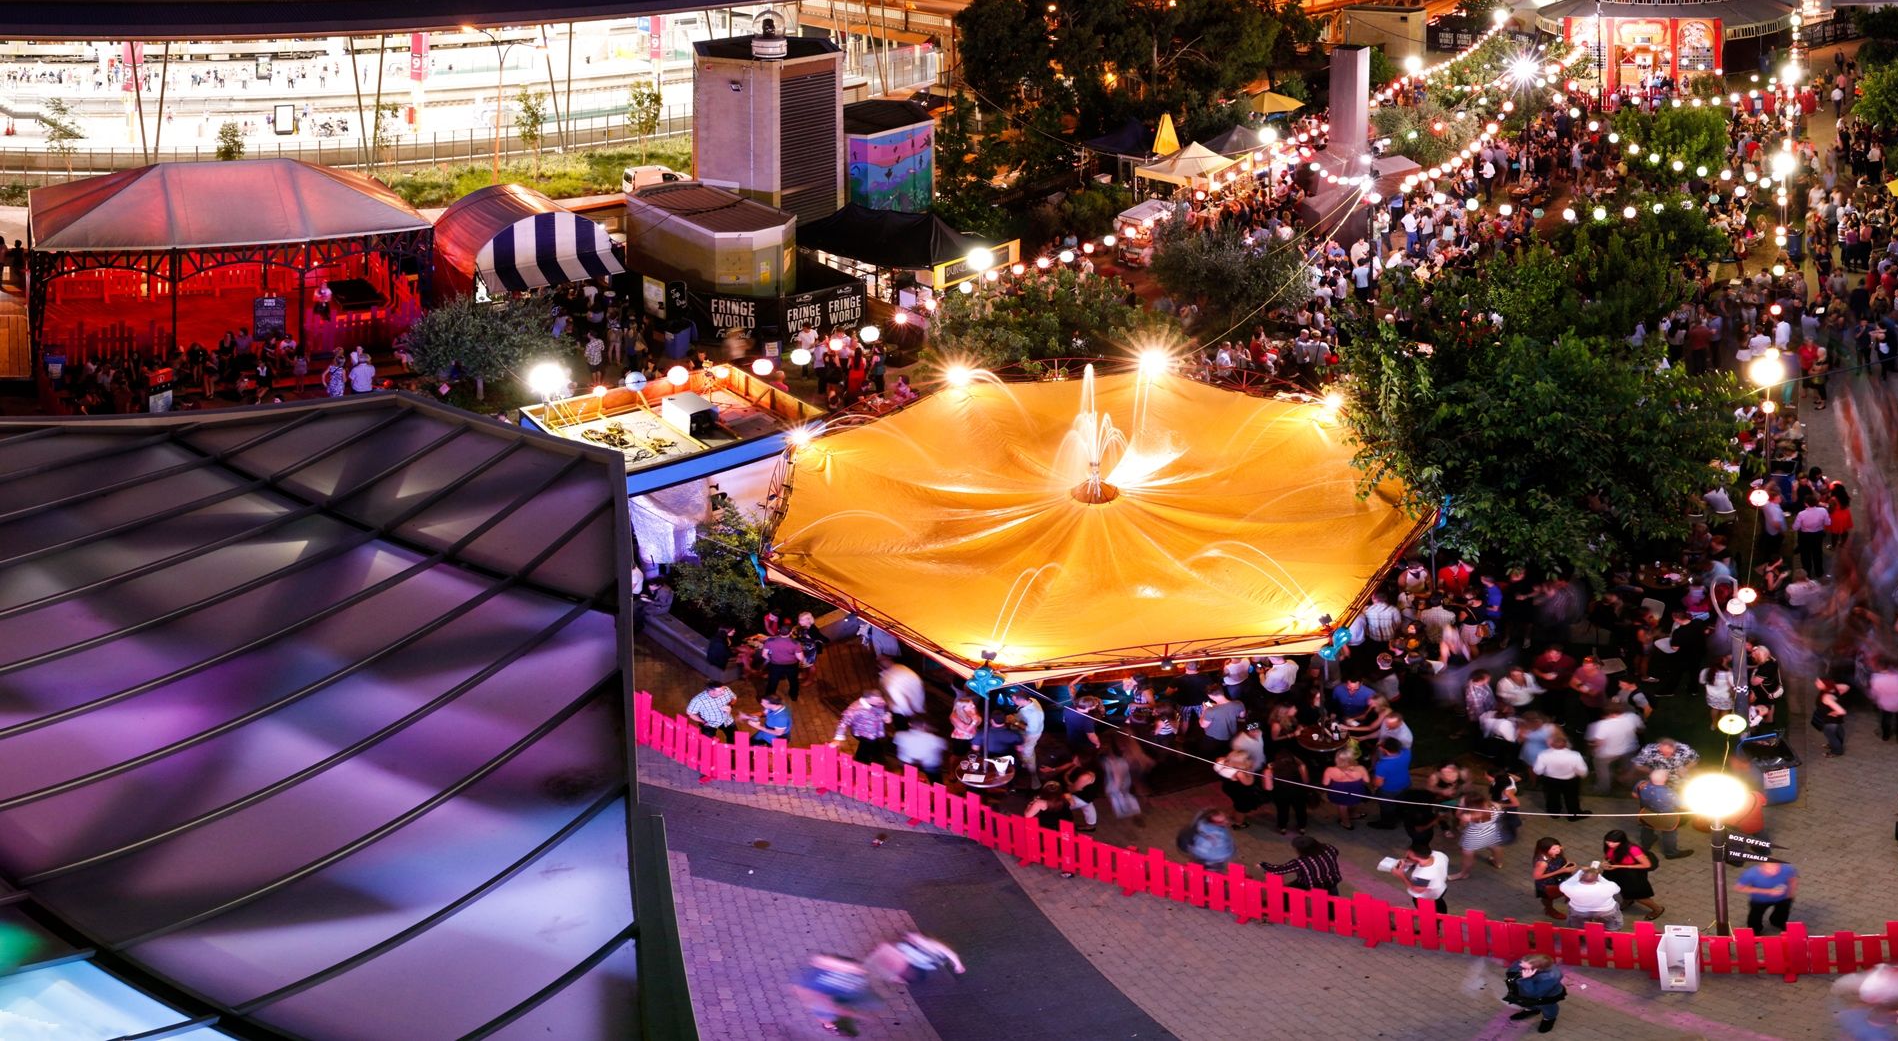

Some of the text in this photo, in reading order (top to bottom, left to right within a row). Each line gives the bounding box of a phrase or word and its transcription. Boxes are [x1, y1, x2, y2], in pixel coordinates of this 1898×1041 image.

[412, 58, 421, 68] 9
[711, 299, 755, 316] FRINGE
[787, 303, 821, 321] FRINGE
[829, 295, 861, 313] FRINGE
[712, 313, 756, 329] WORLD
[829, 307, 861, 325] WORLD
[1728, 834, 1771, 848] BOX OFFICE
[1742, 853, 1768, 861] STABLES
